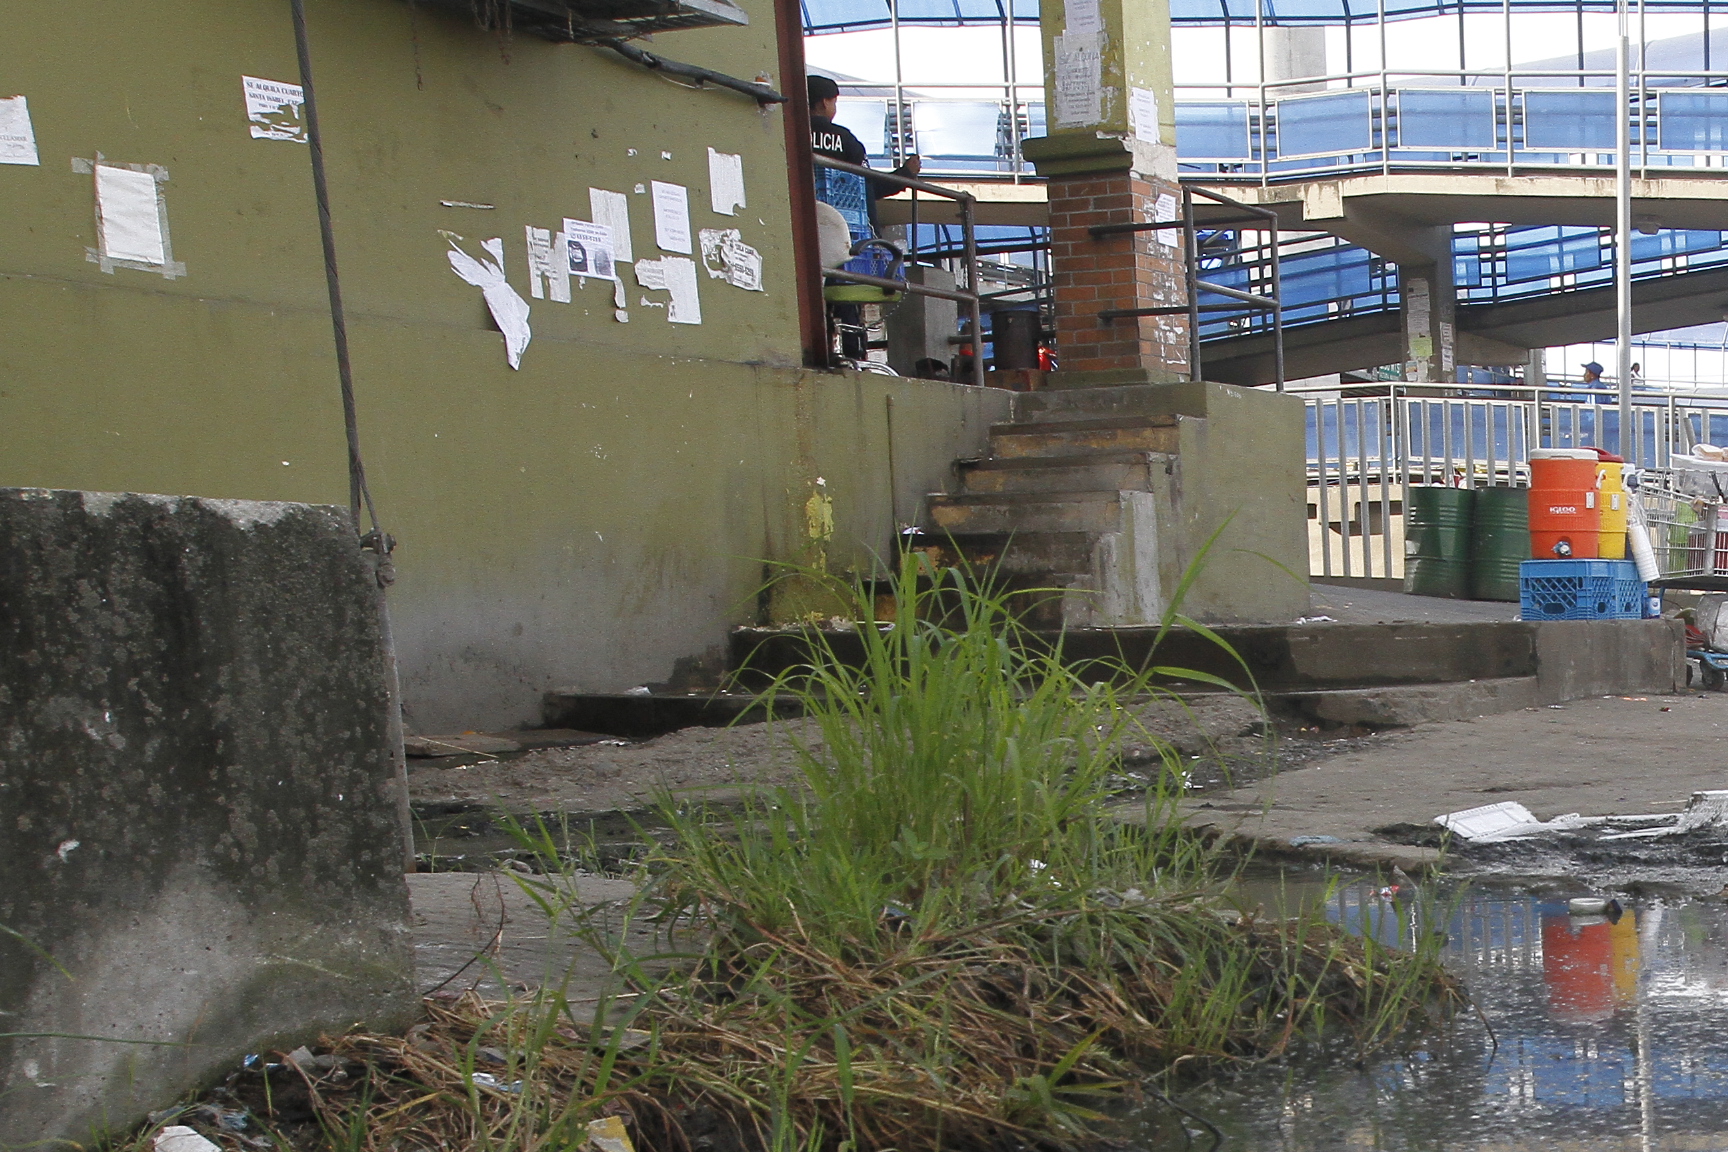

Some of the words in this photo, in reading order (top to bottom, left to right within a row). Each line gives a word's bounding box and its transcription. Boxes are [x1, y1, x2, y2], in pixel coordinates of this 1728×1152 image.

[255, 83, 280, 93] ALQUILA
[248, 91, 266, 101] SANTA
[810, 131, 843, 152] LICIA
[1549, 506, 1576, 514] IGLOO
